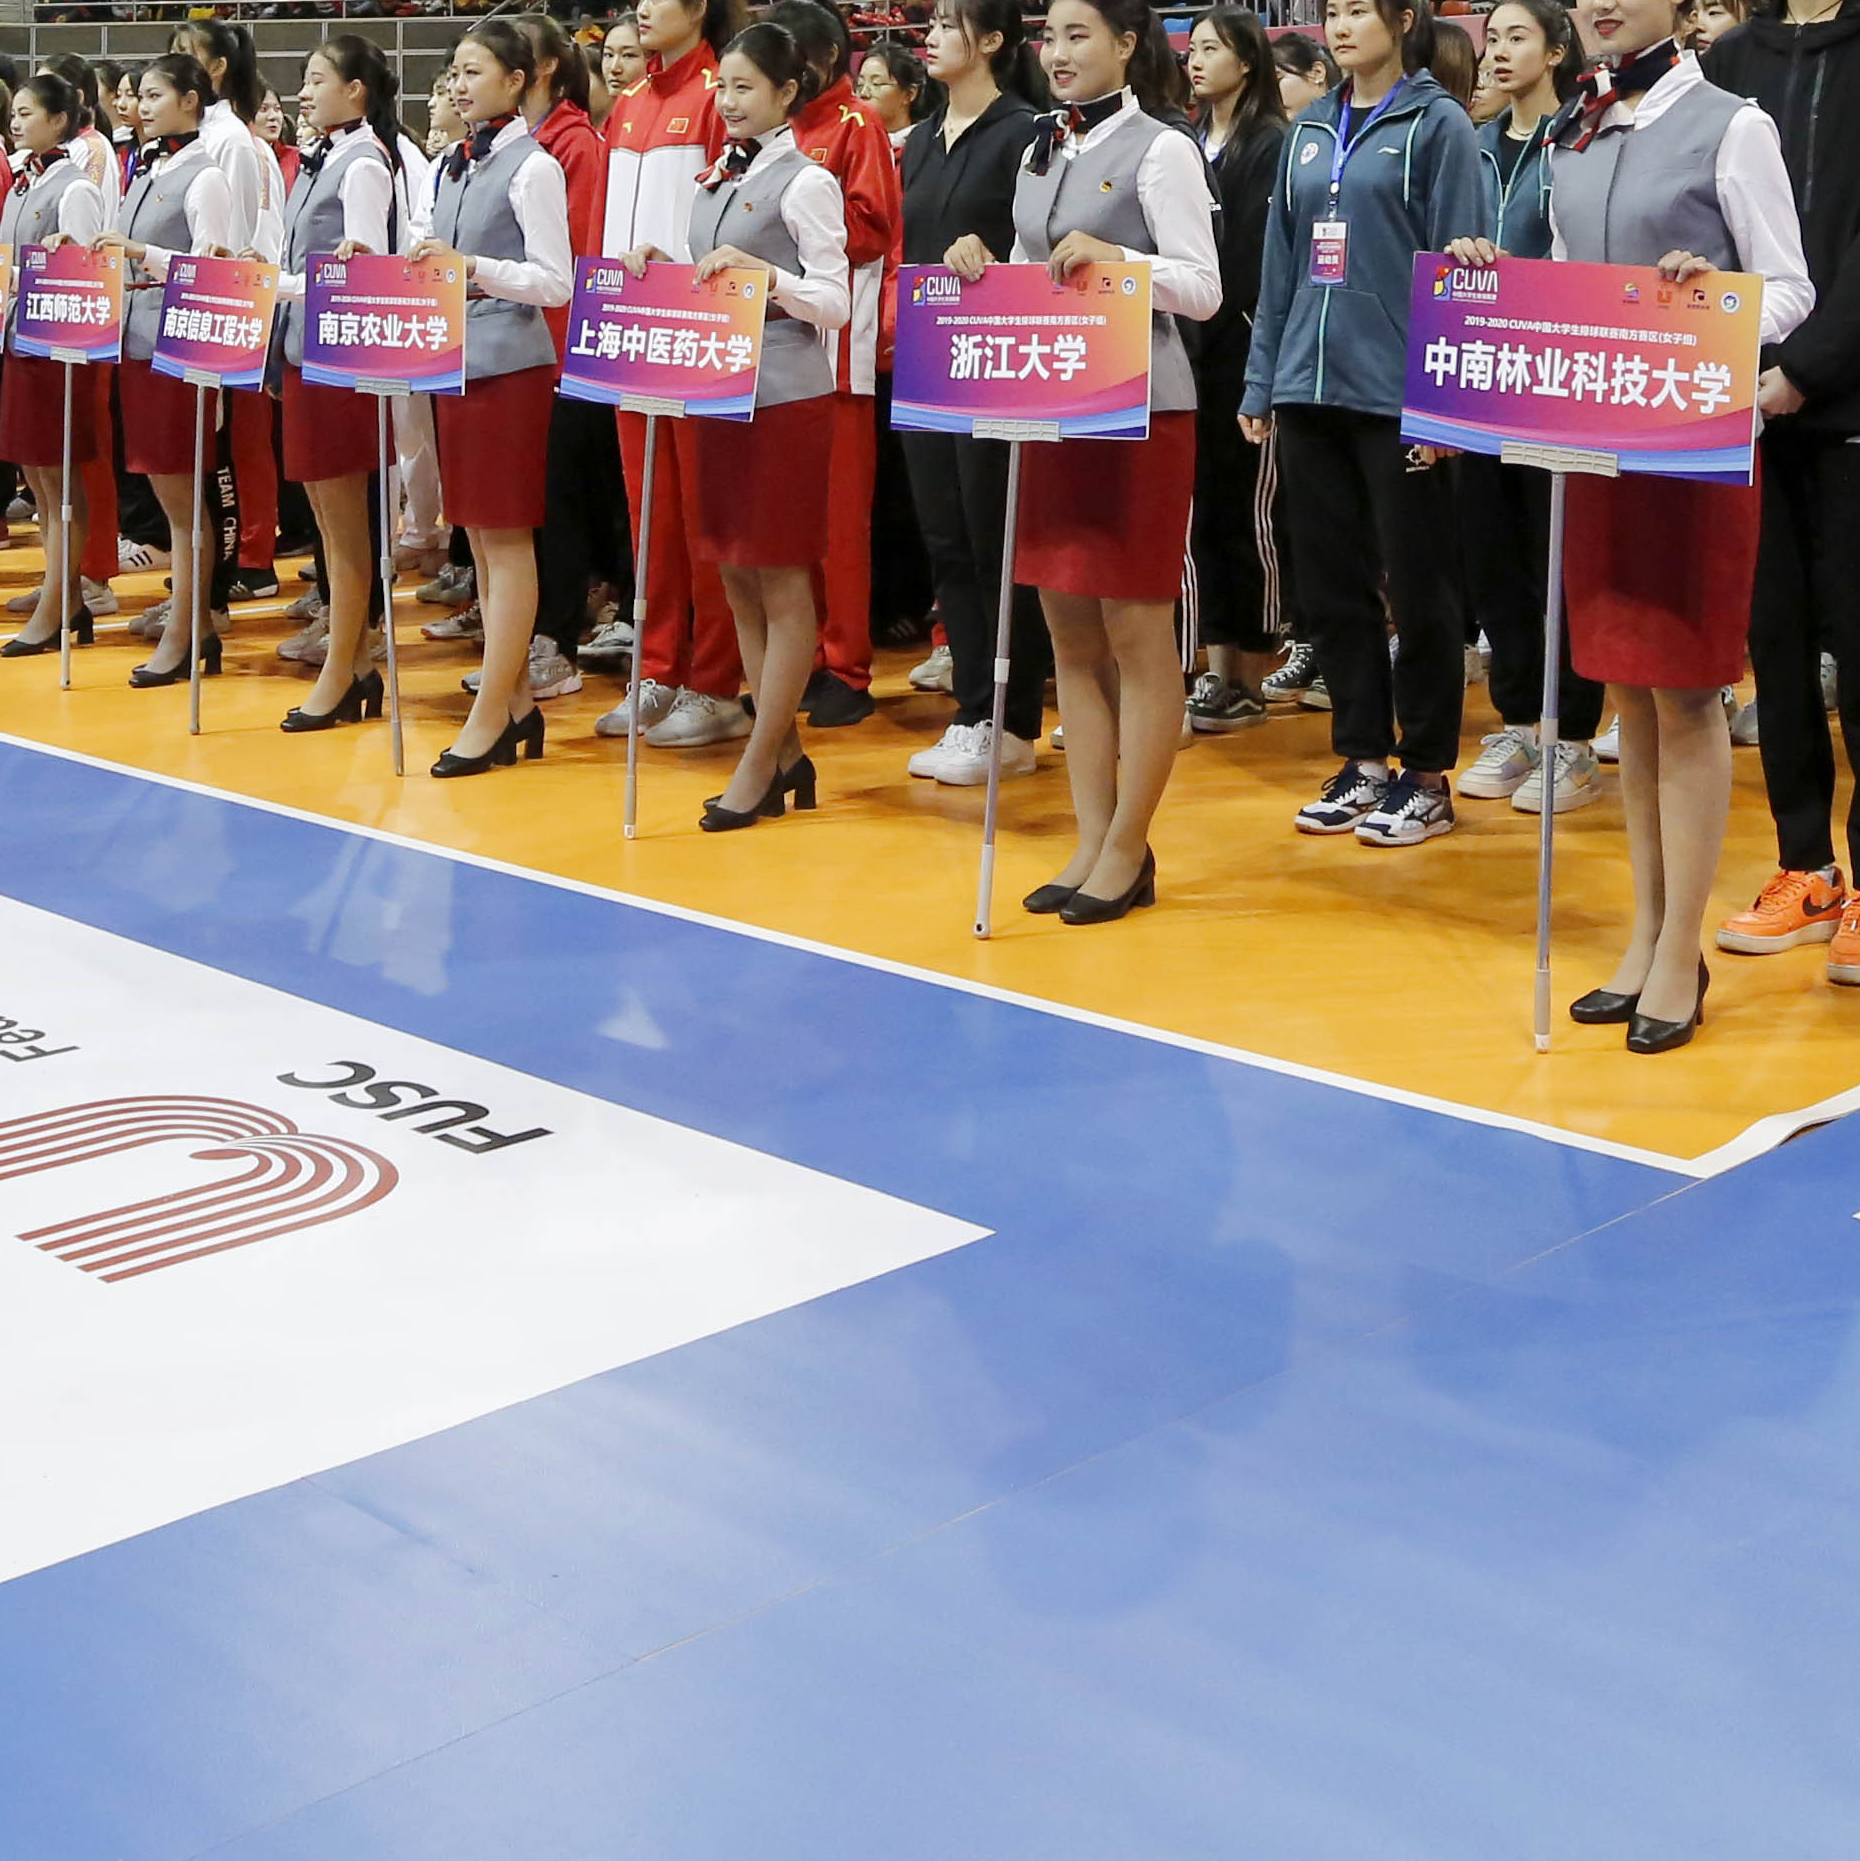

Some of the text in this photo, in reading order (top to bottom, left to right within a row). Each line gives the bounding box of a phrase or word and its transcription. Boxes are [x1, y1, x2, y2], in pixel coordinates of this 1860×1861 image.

[324, 263, 347, 280] CUVA
[597, 268, 624, 287] CUVA
[926, 276, 961, 296] CUVA
[1452, 267, 1499, 293] CUVA
[25, 292, 111, 325] 江西师范大学
[163, 305, 263, 349] 南京信息工程大学
[1464, 314, 1508, 330] 2019-2020
[317, 310, 448, 352] 南京农业大学
[569, 319, 754, 373] 上海中医药大学
[949, 333, 1087, 381] 浙江大学
[1423, 336, 1732, 415] 中南林业科技大学
[277, 1060, 554, 1154] FUSC
